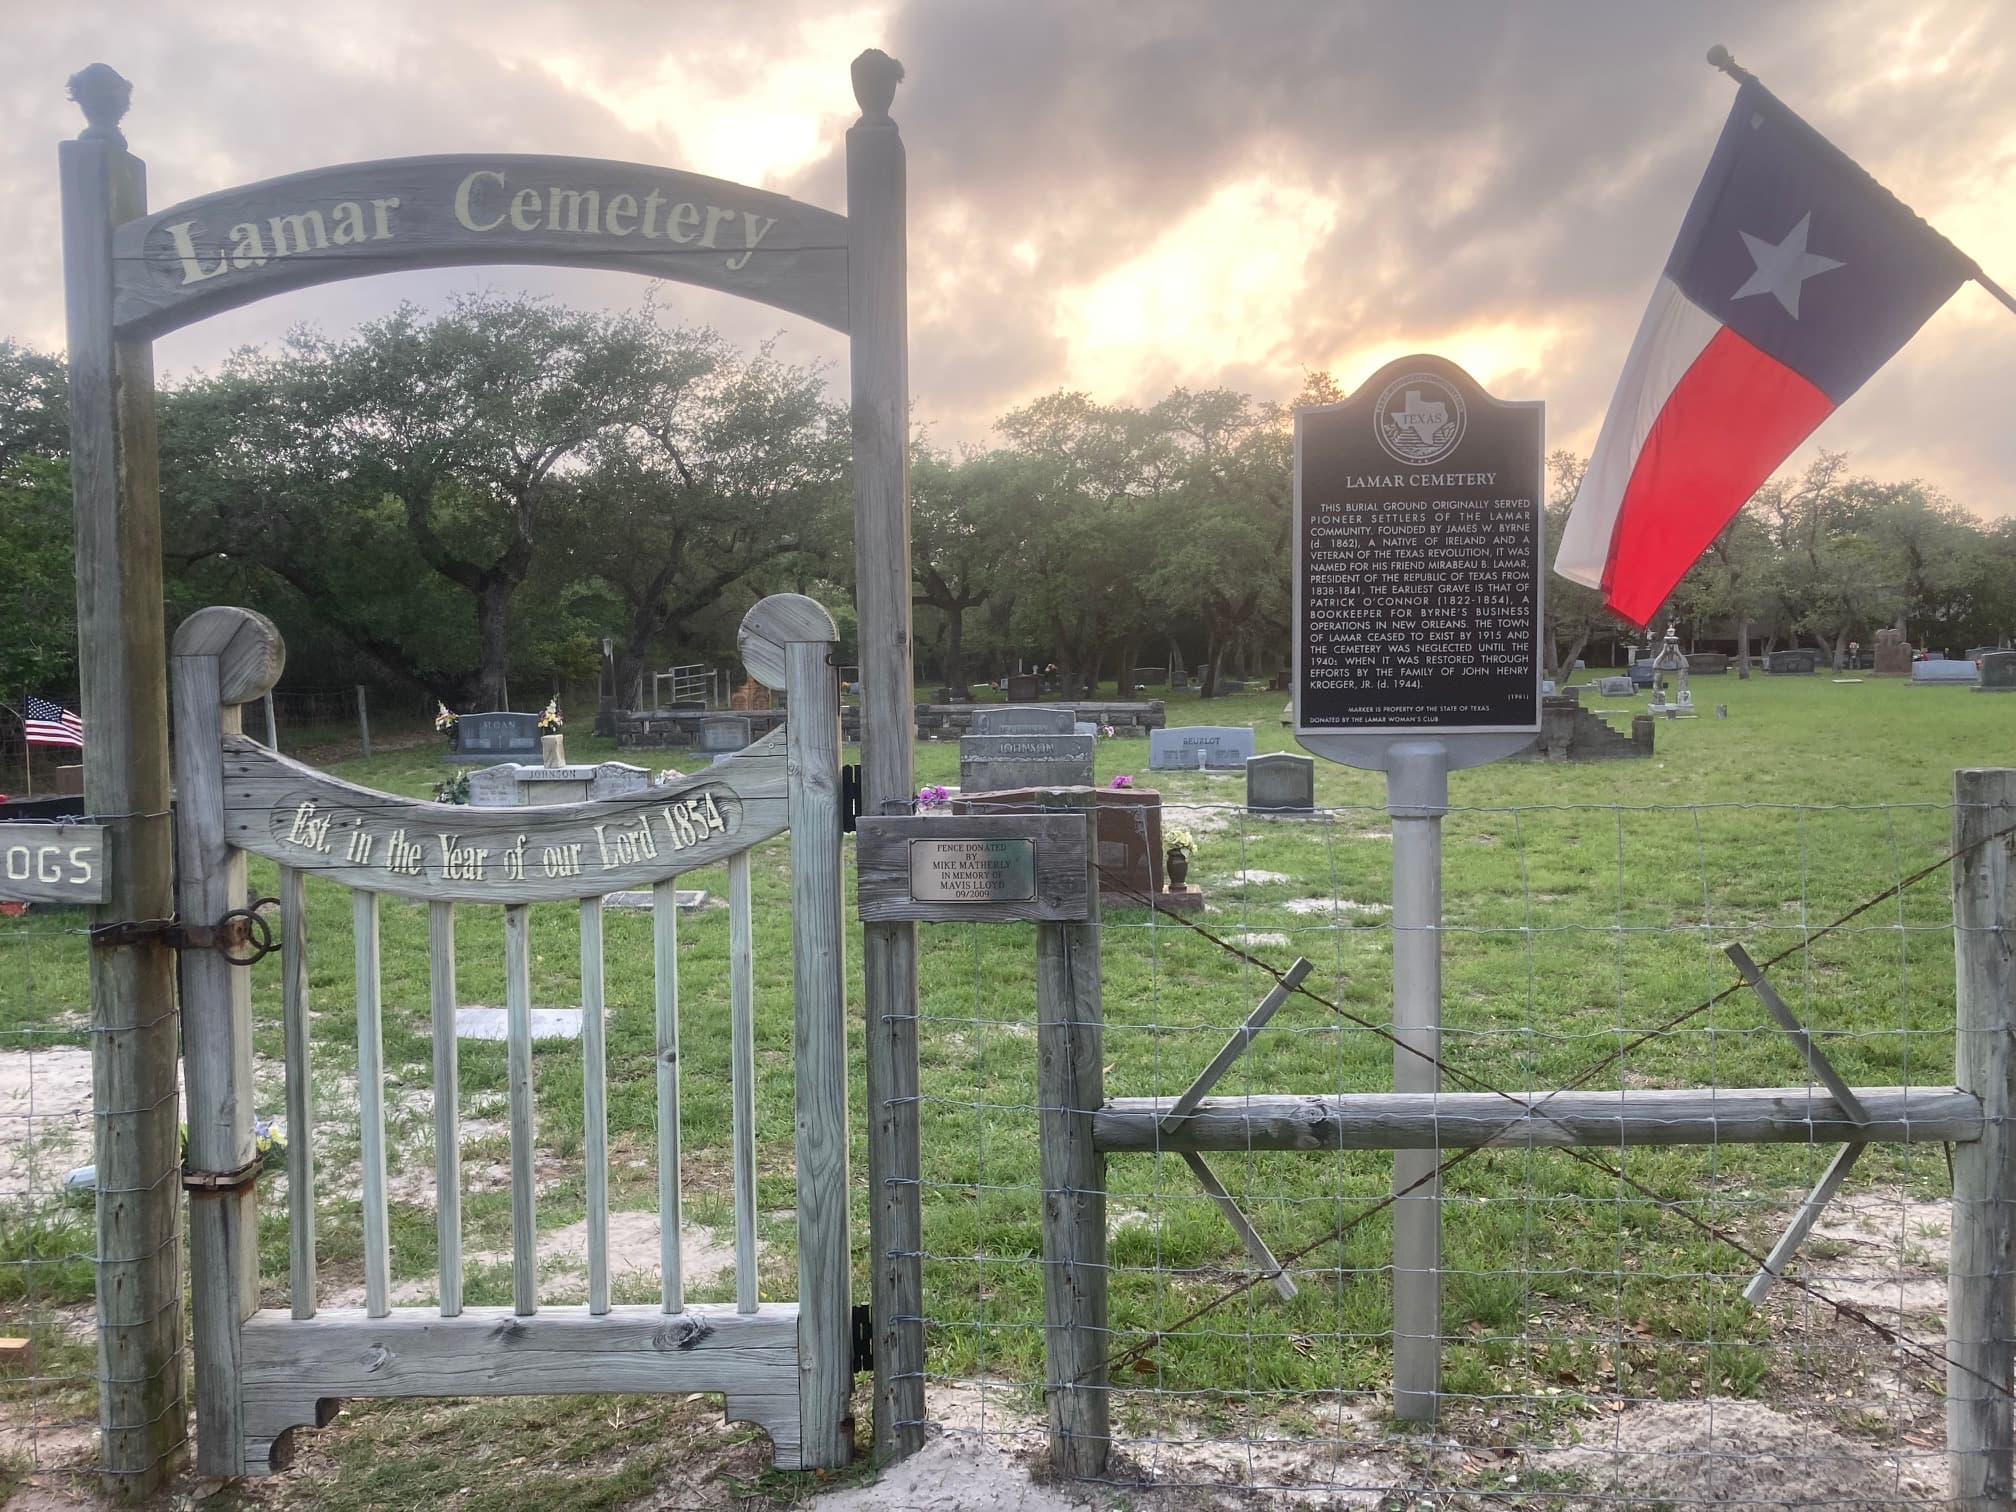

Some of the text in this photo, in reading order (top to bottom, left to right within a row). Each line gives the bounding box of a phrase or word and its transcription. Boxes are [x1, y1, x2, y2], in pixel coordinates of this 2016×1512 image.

[163, 169, 778, 286] Lamar Cemetery
[1401, 414, 1442, 425] TEXAS
[1346, 474, 1496, 487] LAMAR CEMETERY
[1321, 500, 1530, 512] THIS BURIAL GROUND ORIGINALLY SERVED
[1311, 515, 1361, 524] PIONEER
[1372, 514, 1425, 522] SETTLERS
[1435, 513, 1450, 521] OF
[1490, 512, 1529, 520] LAMAR
[1378, 526, 1425, 534] FOUNDED
[1431, 525, 1441, 533] BY
[1446, 525, 1477, 533] JAMES
[1499, 524, 1529, 532] BYRNE
[1383, 538, 1417, 546] NATIVE
[1425, 537, 1438, 545] OF
[1446, 537, 1485, 545] IRELAND
[1493, 536, 1515, 544] AND
[1311, 551, 1353, 559] VETERAN
[1356, 550, 1370, 559] OF
[1374, 550, 1391, 558] THE
[1395, 550, 1424, 558] TEXAS
[1497, 548, 1504, 556] IT
[1311, 563, 1346, 571] NAMED
[1350, 563, 1368, 571] FOR
[1372, 562, 1387, 570] HIS
[1391, 562, 1424, 570] FRIEND
[1428, 561, 1477, 569] MIRABEAU
[1482, 560, 1489, 568] B.
[1311, 575, 1360, 583] PRESIDENT
[1364, 574, 1377, 582] OF
[1382, 574, 1399, 582] THE
[1404, 573, 1446, 581] REPUBLIC
[1451, 573, 1464, 581] OF
[1469, 572, 1497, 580] TEXAS
[1312, 587, 1364, 595] 1838-1841.
[1370, 586, 1387, 594] THE
[1392, 585, 1433, 593] EARLIEST
[1475, 584, 1483, 592] IS
[1488, 584, 1511, 592] THAT
[1516, 583, 1529, 591] OF
[1363, 597, 1428, 605] O'CONNOR
[1311, 607, 1529, 618] BOOKKEEPER FOR BYRNE'S BUSINESS
[1310, 622, 1370, 630] OPERATIONS
[1376, 621, 1386, 629] IN
[1393, 621, 1416, 629] NEW
[1421, 620, 1468, 628] ORLEANS.
[1498, 619, 1529, 627] TOWN
[1310, 634, 1323, 642] OF
[1368, 633, 1405, 641] CEASED
[1410, 632, 1423, 640] TO
[1430, 632, 1454, 640] EXIST
[1460, 632, 1471, 640] BY
[1479, 631, 1501, 639] 1915
[1507, 631, 1529, 639] AND
[1311, 646, 1327, 654] THE
[1334, 645, 1381, 653] CEMETERY
[1417, 644, 1472, 652] NEGLECTED
[1479, 643, 1505, 651] UNTIL
[1512, 643, 1528, 651] THE
[1345, 657, 1375, 665] WHEN
[1383, 656, 1390, 664] IT
[1397, 656, 1419, 664] WAS
[1481, 655, 1528, 663] THROUGH
[1311, 669, 1349, 677] EFFORTS
[1376, 668, 1393, 676] THE
[1401, 668, 1433, 676] FAMILY
[1441, 667, 1454, 675] OF
[1462, 667, 1489, 675] JOHN
[1497, 667, 1528, 675] HENRY
[1361, 680, 1373, 688] JR.
[1377, 680, 1389, 688] (d.
[1394, 680, 1422, 688] 1944).
[1000, 743, 1055, 753] JOHNSON
[528, 769, 576, 779] JOHNSON
[286, 791, 726, 881] Est. in the Year of our Lord 1854
[959, 861, 1010, 869] MATHERLY
[974, 881, 1004, 889] LLOYD
[956, 890, 989, 898] 09/2009
